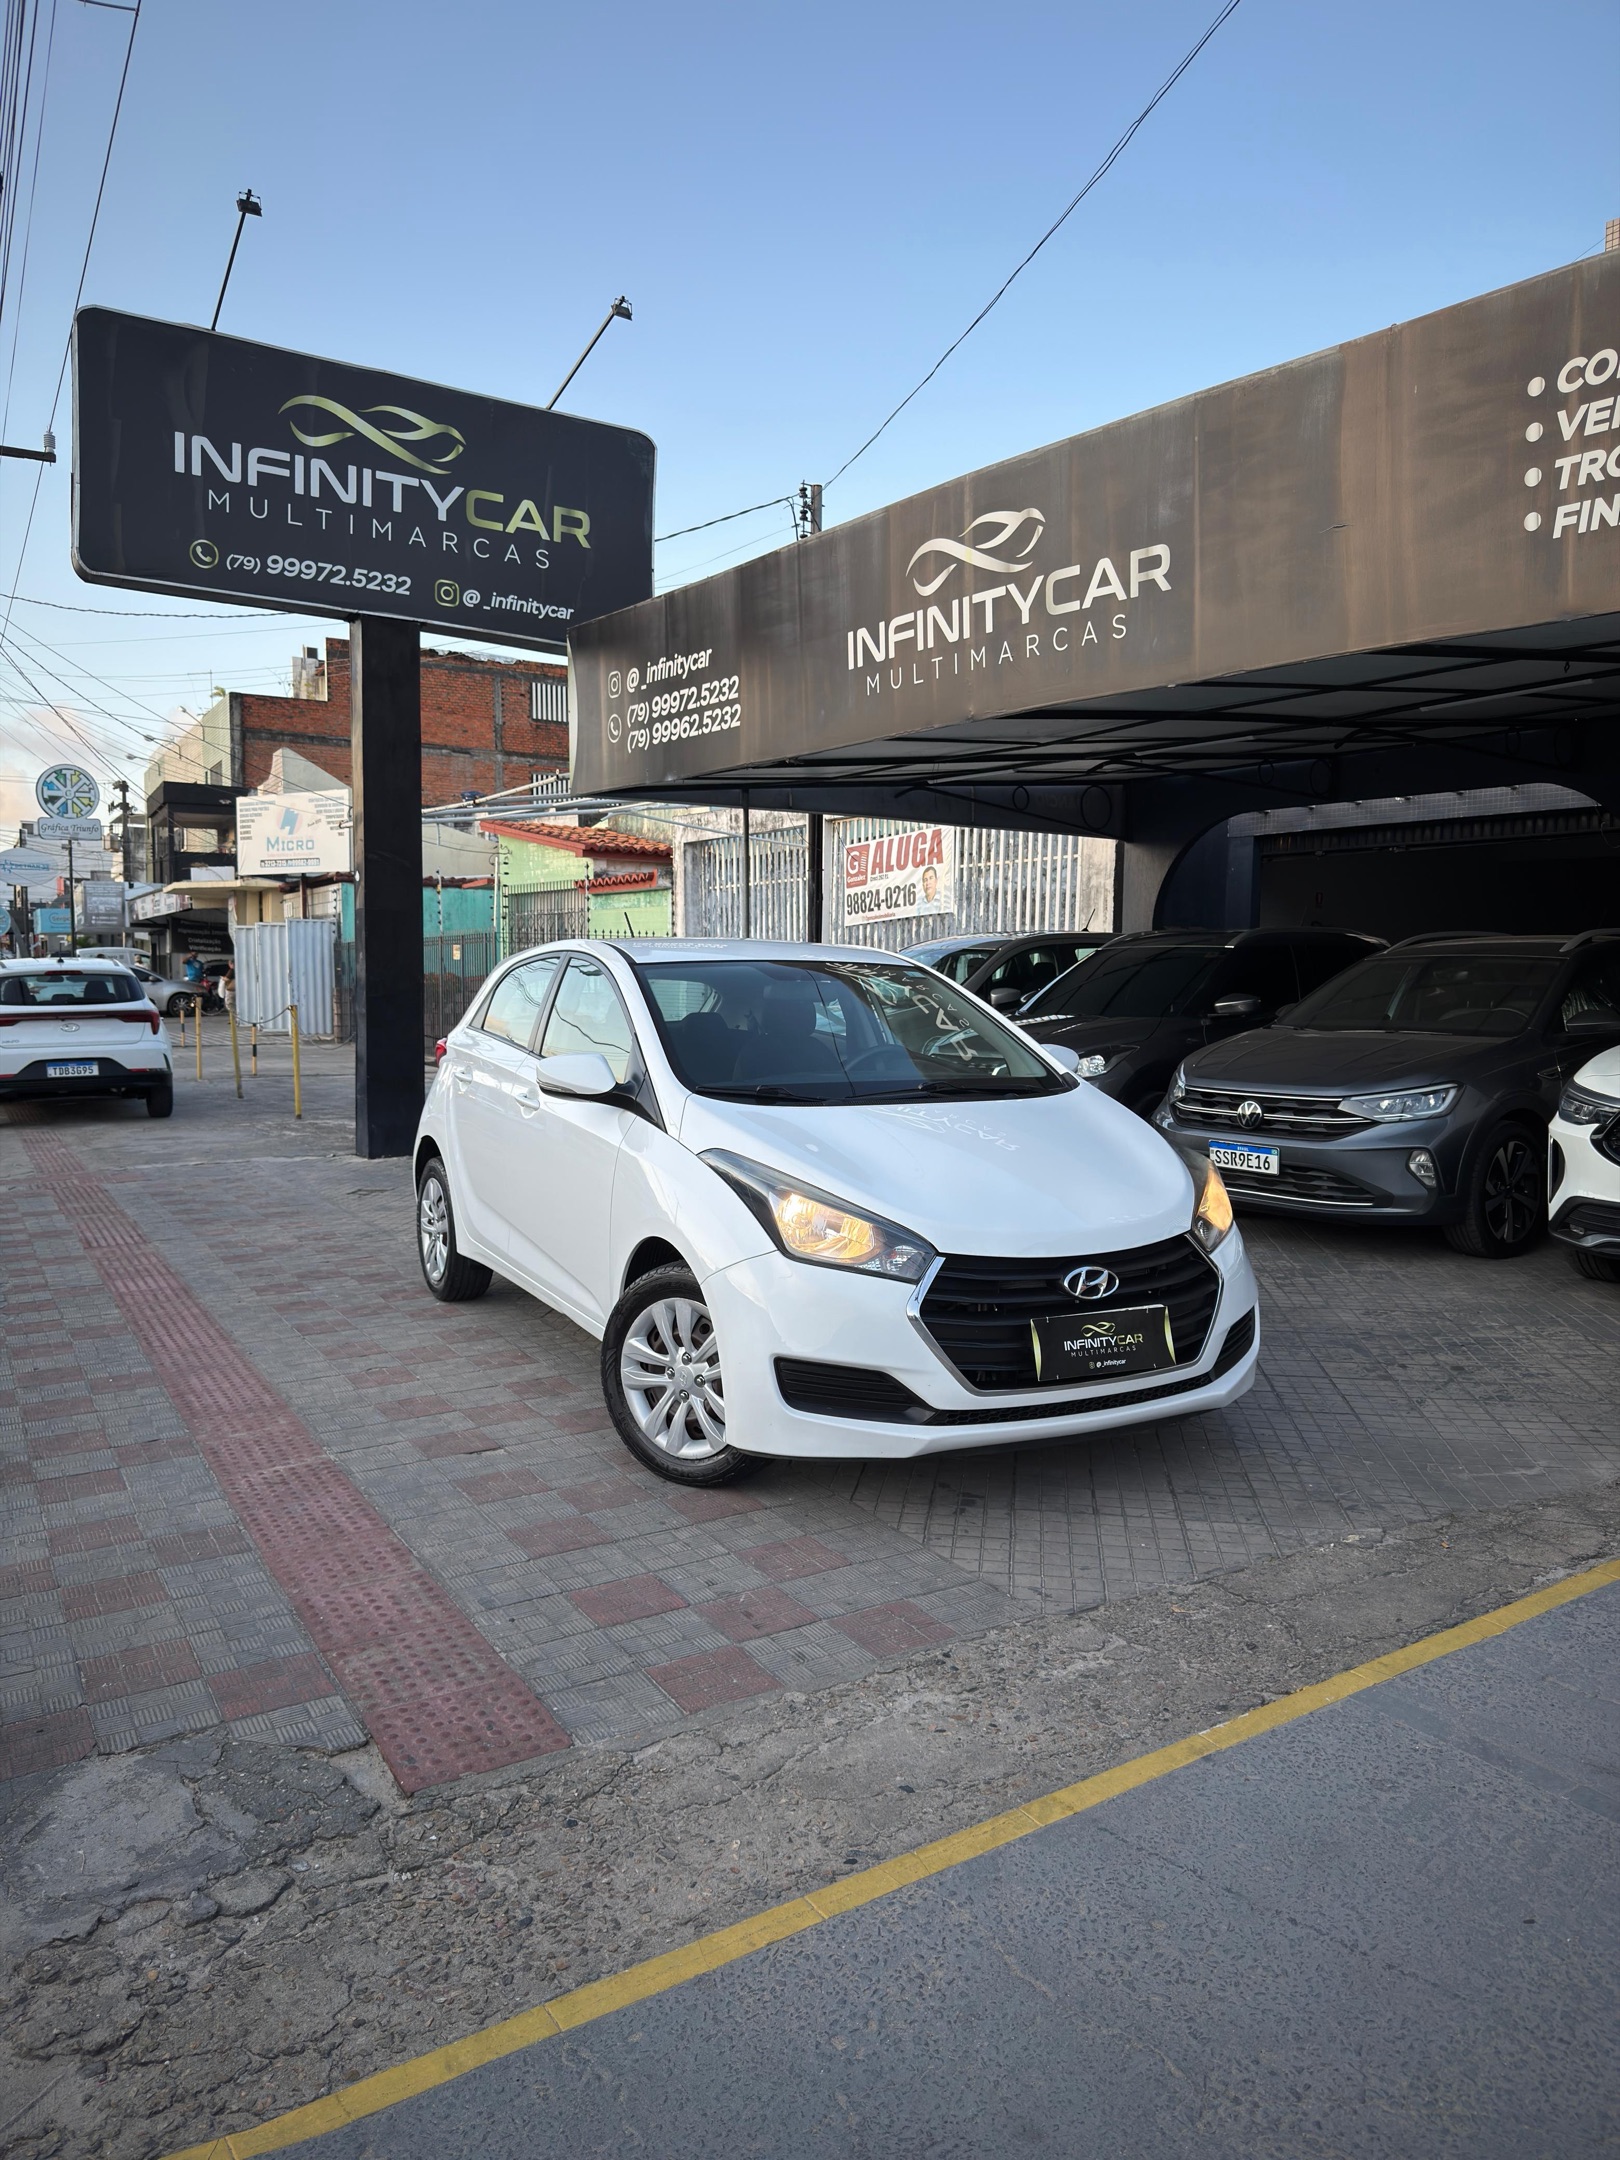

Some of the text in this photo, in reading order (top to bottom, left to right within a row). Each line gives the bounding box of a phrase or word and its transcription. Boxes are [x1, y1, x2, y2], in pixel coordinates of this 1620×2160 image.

[1557, 349, 1620, 393] CO
[174, 431, 592, 549] INFINITYCAR
[208, 489, 551, 570] MULTIMARCAS
[1553, 494, 1620, 539] FIN
[226, 553, 411, 596] (79) 99972.5232
[847, 543, 1172, 670] INFINITYCAR
[866, 613, 1128, 696] MULTIMARCAS
[627, 675, 739, 728] (79) 99972.5232
[627, 704, 741, 753] (79) 99962.5232
[41, 822, 69, 834] Gráfica
[70, 824, 99, 835] Triunfo
[870, 829, 944, 875] ALUGA
[846, 882, 917, 916] 98824-0216
[52, 1065, 94, 1076] TDB3G95
[1214, 1149, 1271, 1171] SSR9E16
[1063, 1333, 1144, 1351] INFINITYCAR
[1071, 1345, 1136, 1357] MULTIMARCAS
